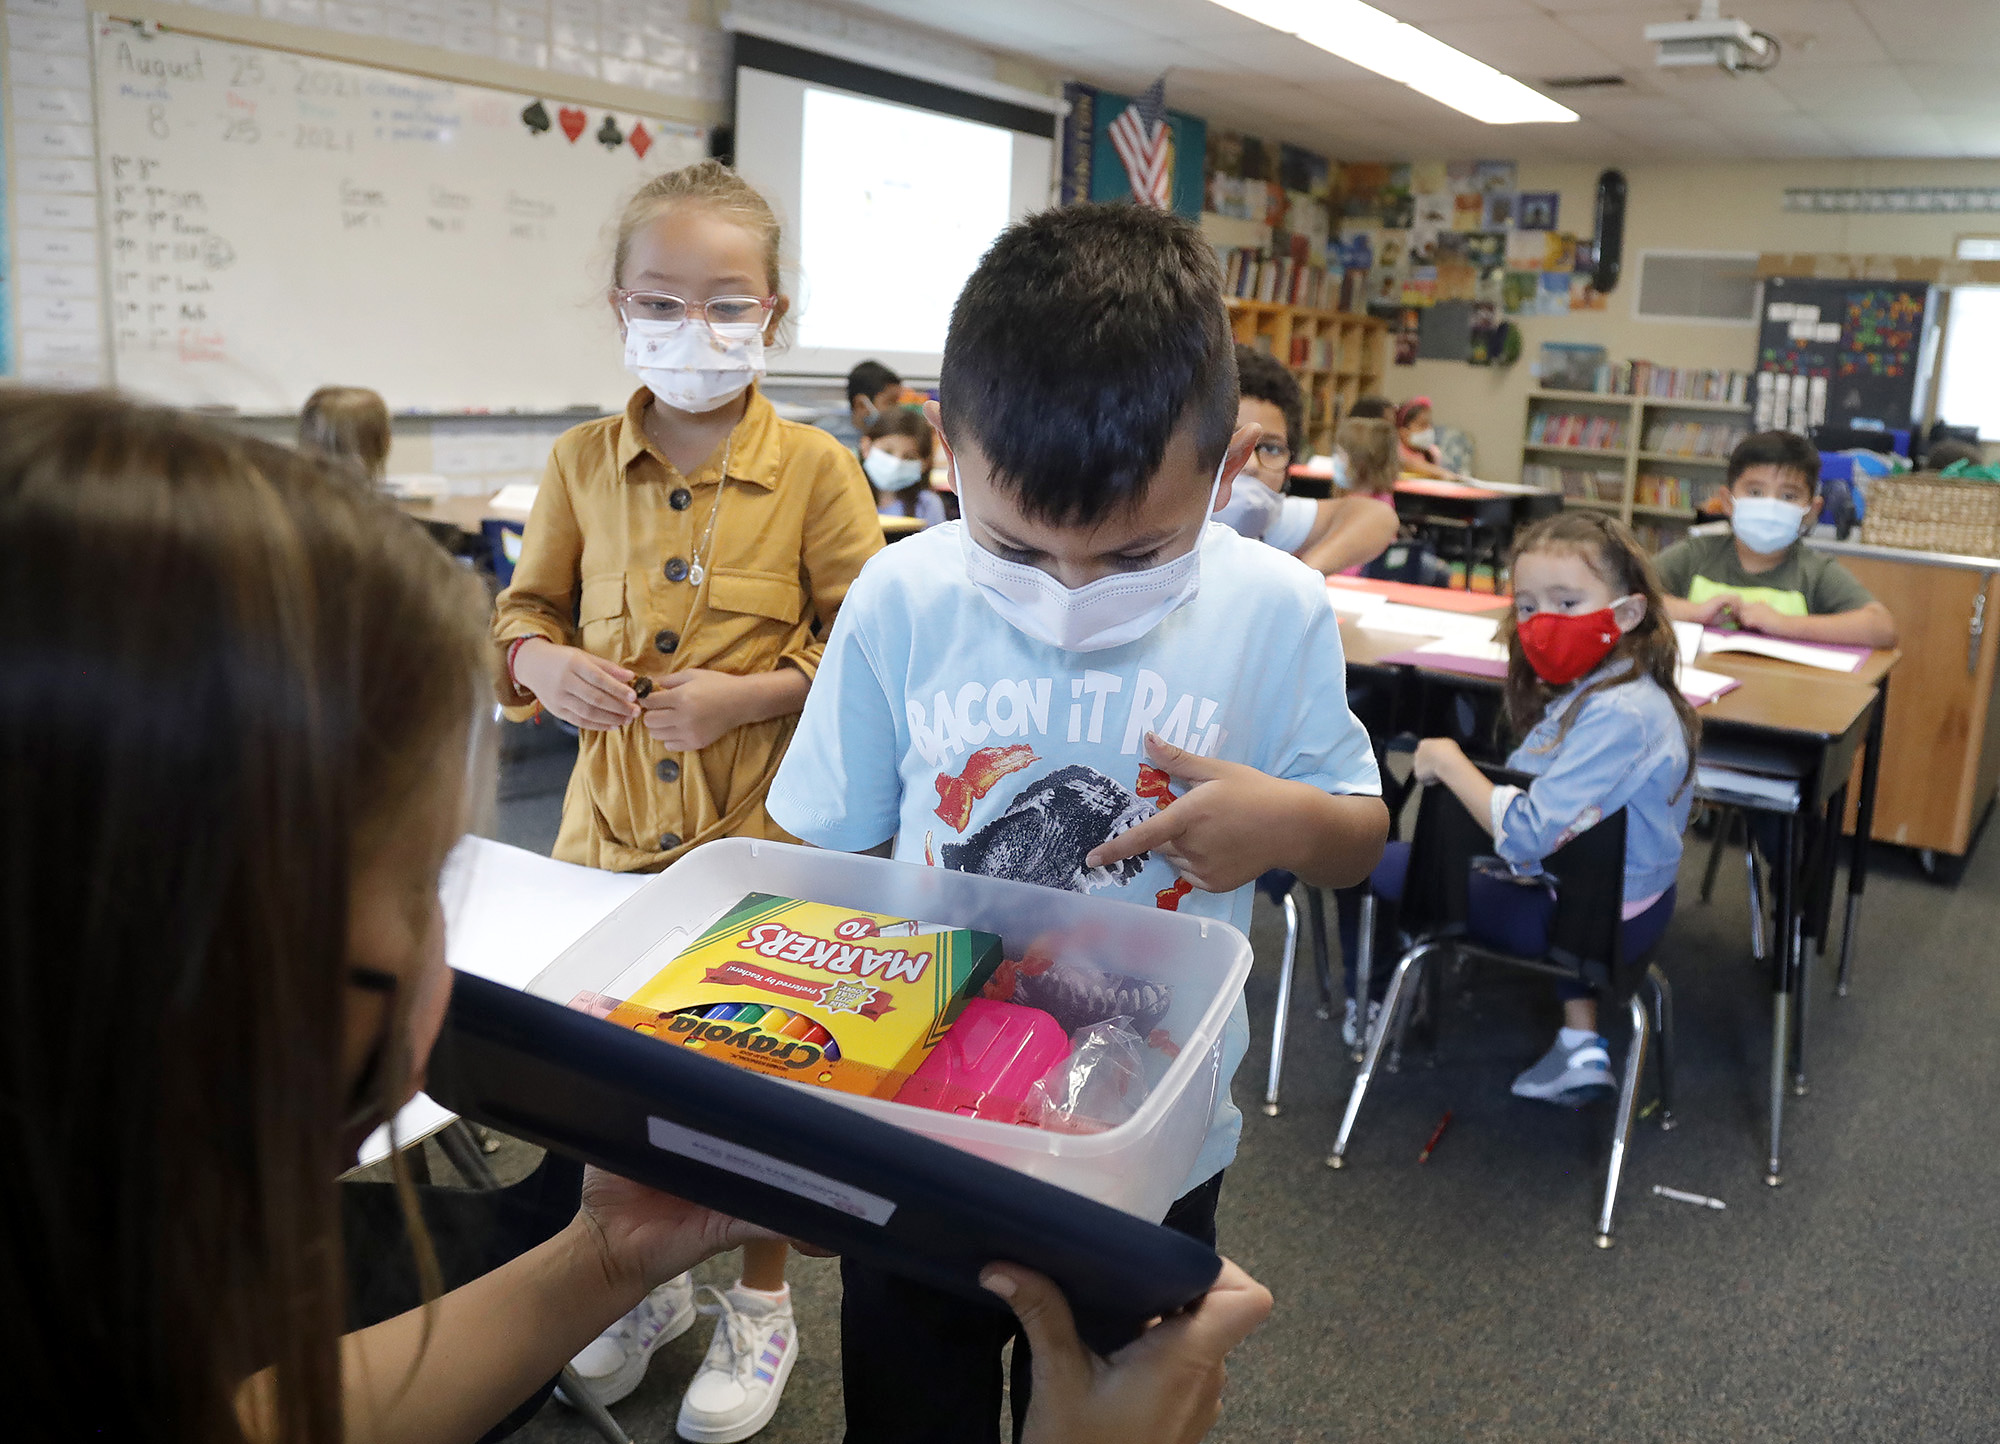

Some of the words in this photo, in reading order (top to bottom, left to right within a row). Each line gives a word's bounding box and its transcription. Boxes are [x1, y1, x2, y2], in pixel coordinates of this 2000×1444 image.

[904, 677, 1053, 768] BACON
[839, 921, 872, 939] 10
[740, 922, 930, 982] MARKERS
[726, 965, 764, 982] Teachers!
[763, 976, 777, 986] by
[775, 980, 818, 995] Preferred
[668, 1016, 820, 1069] Crayola
